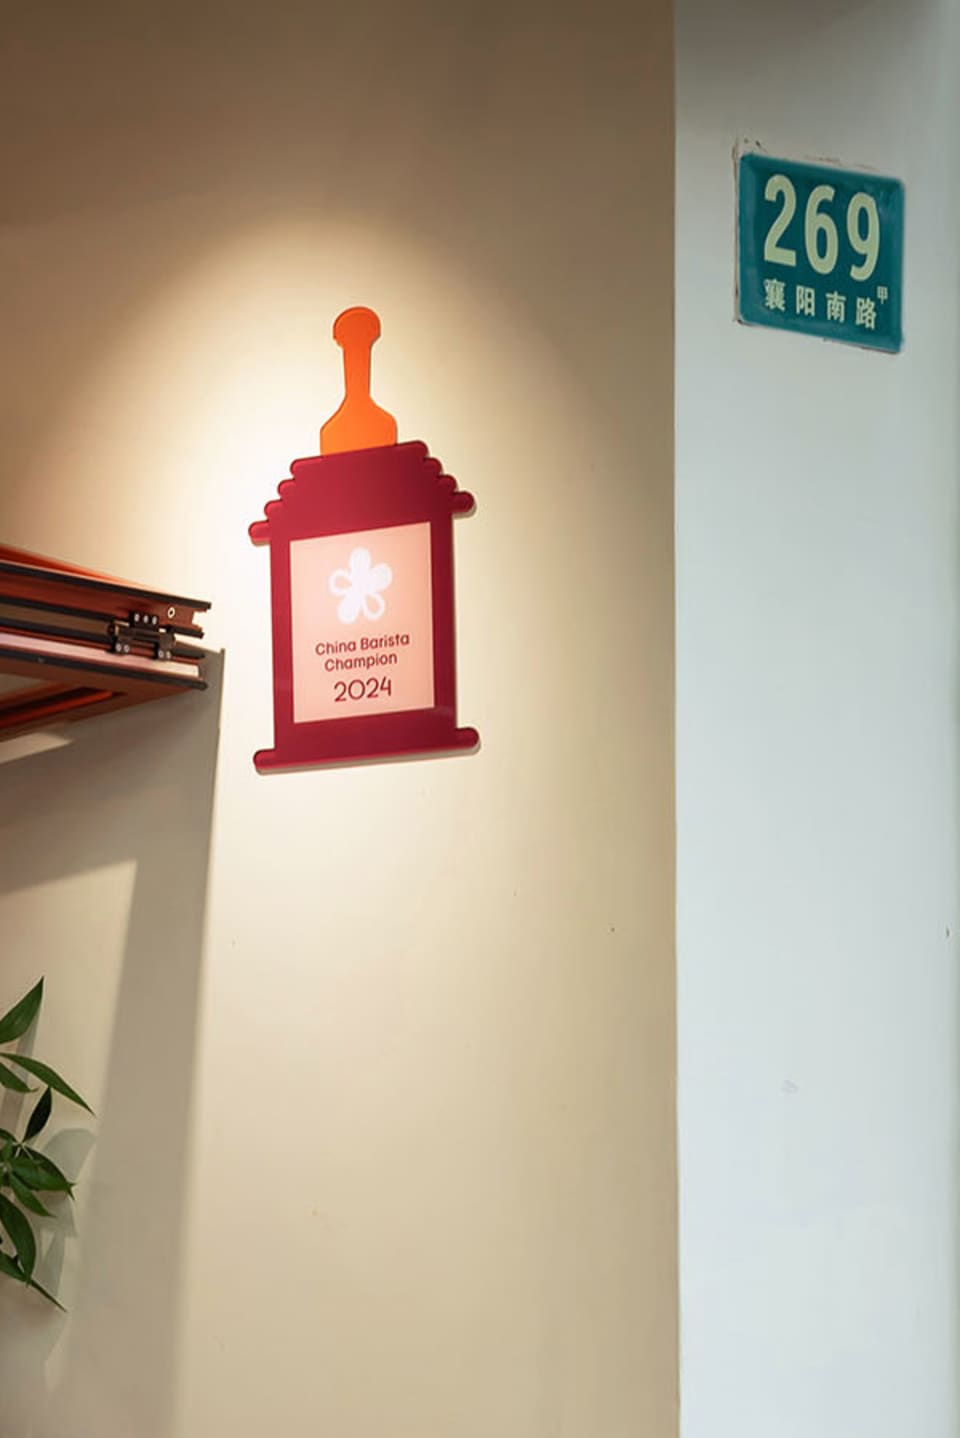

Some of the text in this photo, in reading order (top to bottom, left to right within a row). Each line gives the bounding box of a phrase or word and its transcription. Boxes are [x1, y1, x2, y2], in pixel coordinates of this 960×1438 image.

[764, 174, 880, 281] 269
[764, 279, 876, 329] 襄阳南路
[315, 634, 409, 655] China Barista
[324, 653, 397, 671] Champion
[334, 677, 392, 702] 2024
